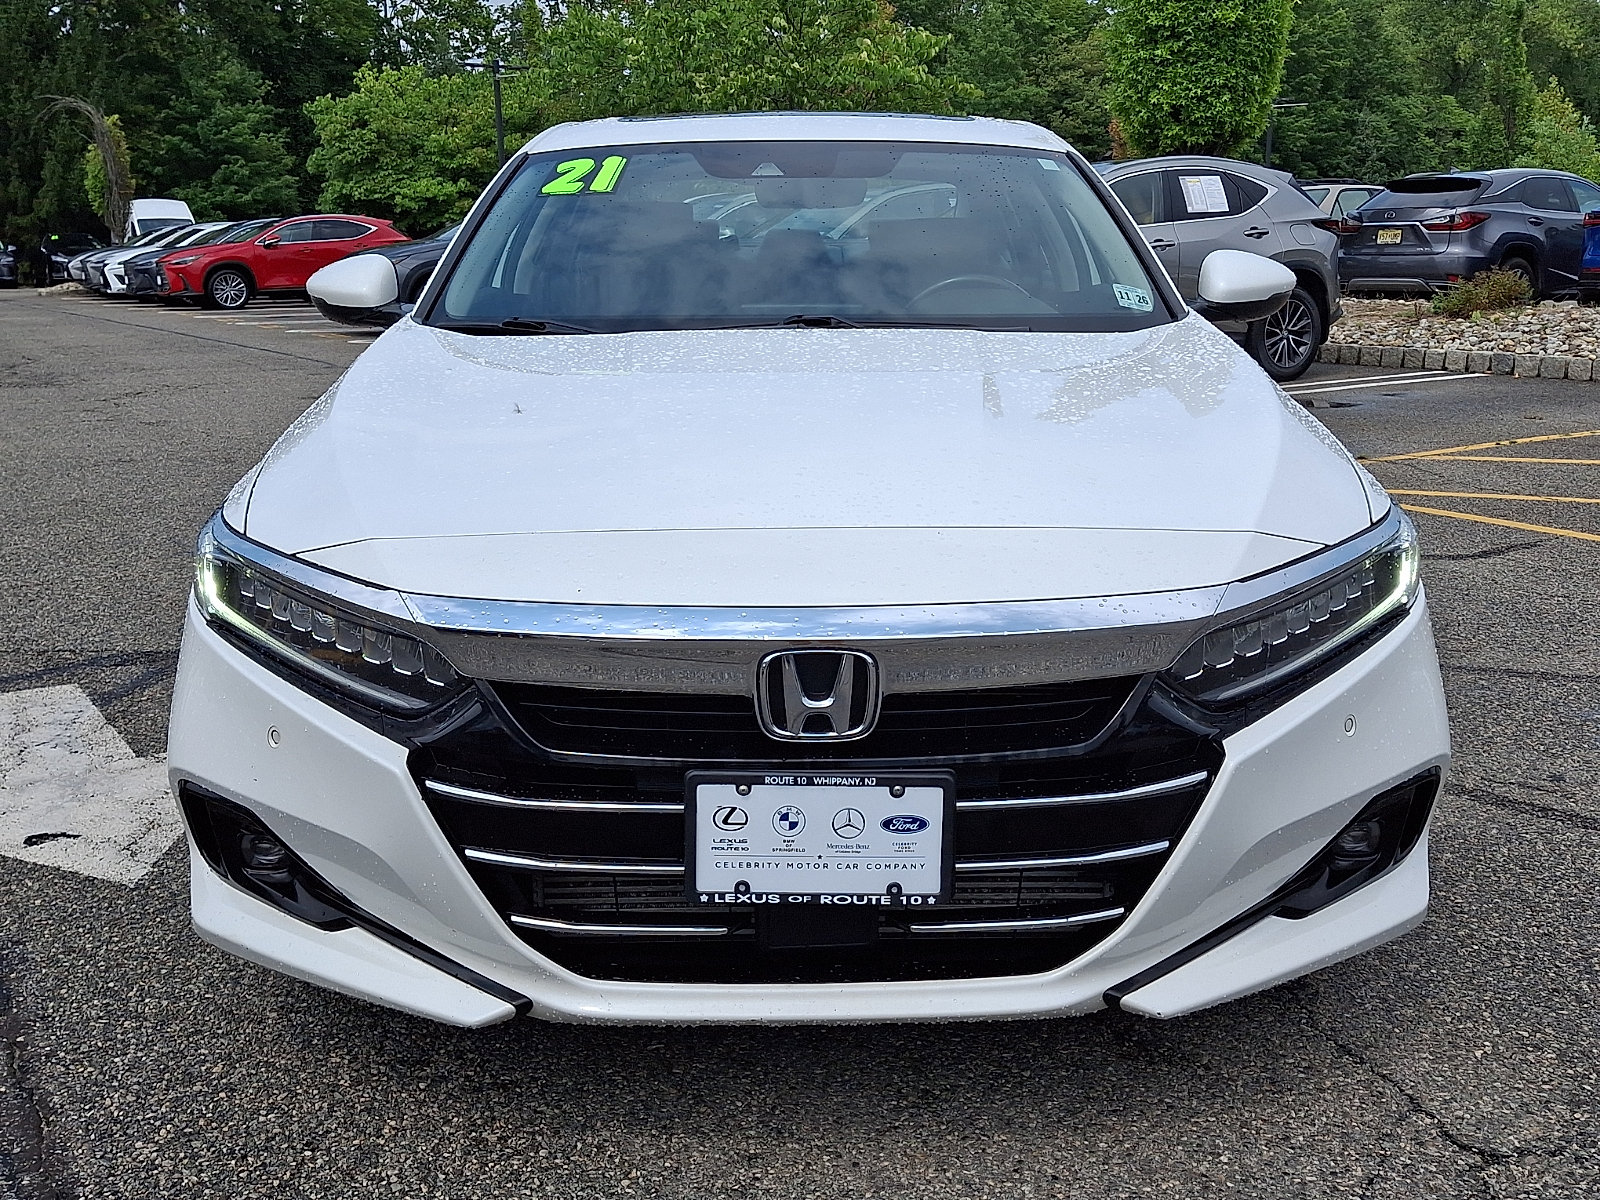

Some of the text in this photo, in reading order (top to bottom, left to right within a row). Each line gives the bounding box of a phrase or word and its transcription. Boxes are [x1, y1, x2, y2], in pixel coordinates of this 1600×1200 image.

[541, 155, 627, 195] 21
[1117, 290, 1149, 305] 11 26
[764, 776, 795, 785] ROUTE
[797, 777, 807, 785] 10
[864, 778, 876, 786] NJ
[889, 818, 920, 831] Ford
[714, 861, 926, 870] CELEBRITY MOTOR CAR COMPANY
[714, 893, 922, 905] LEXUS OF ROUTE 10
